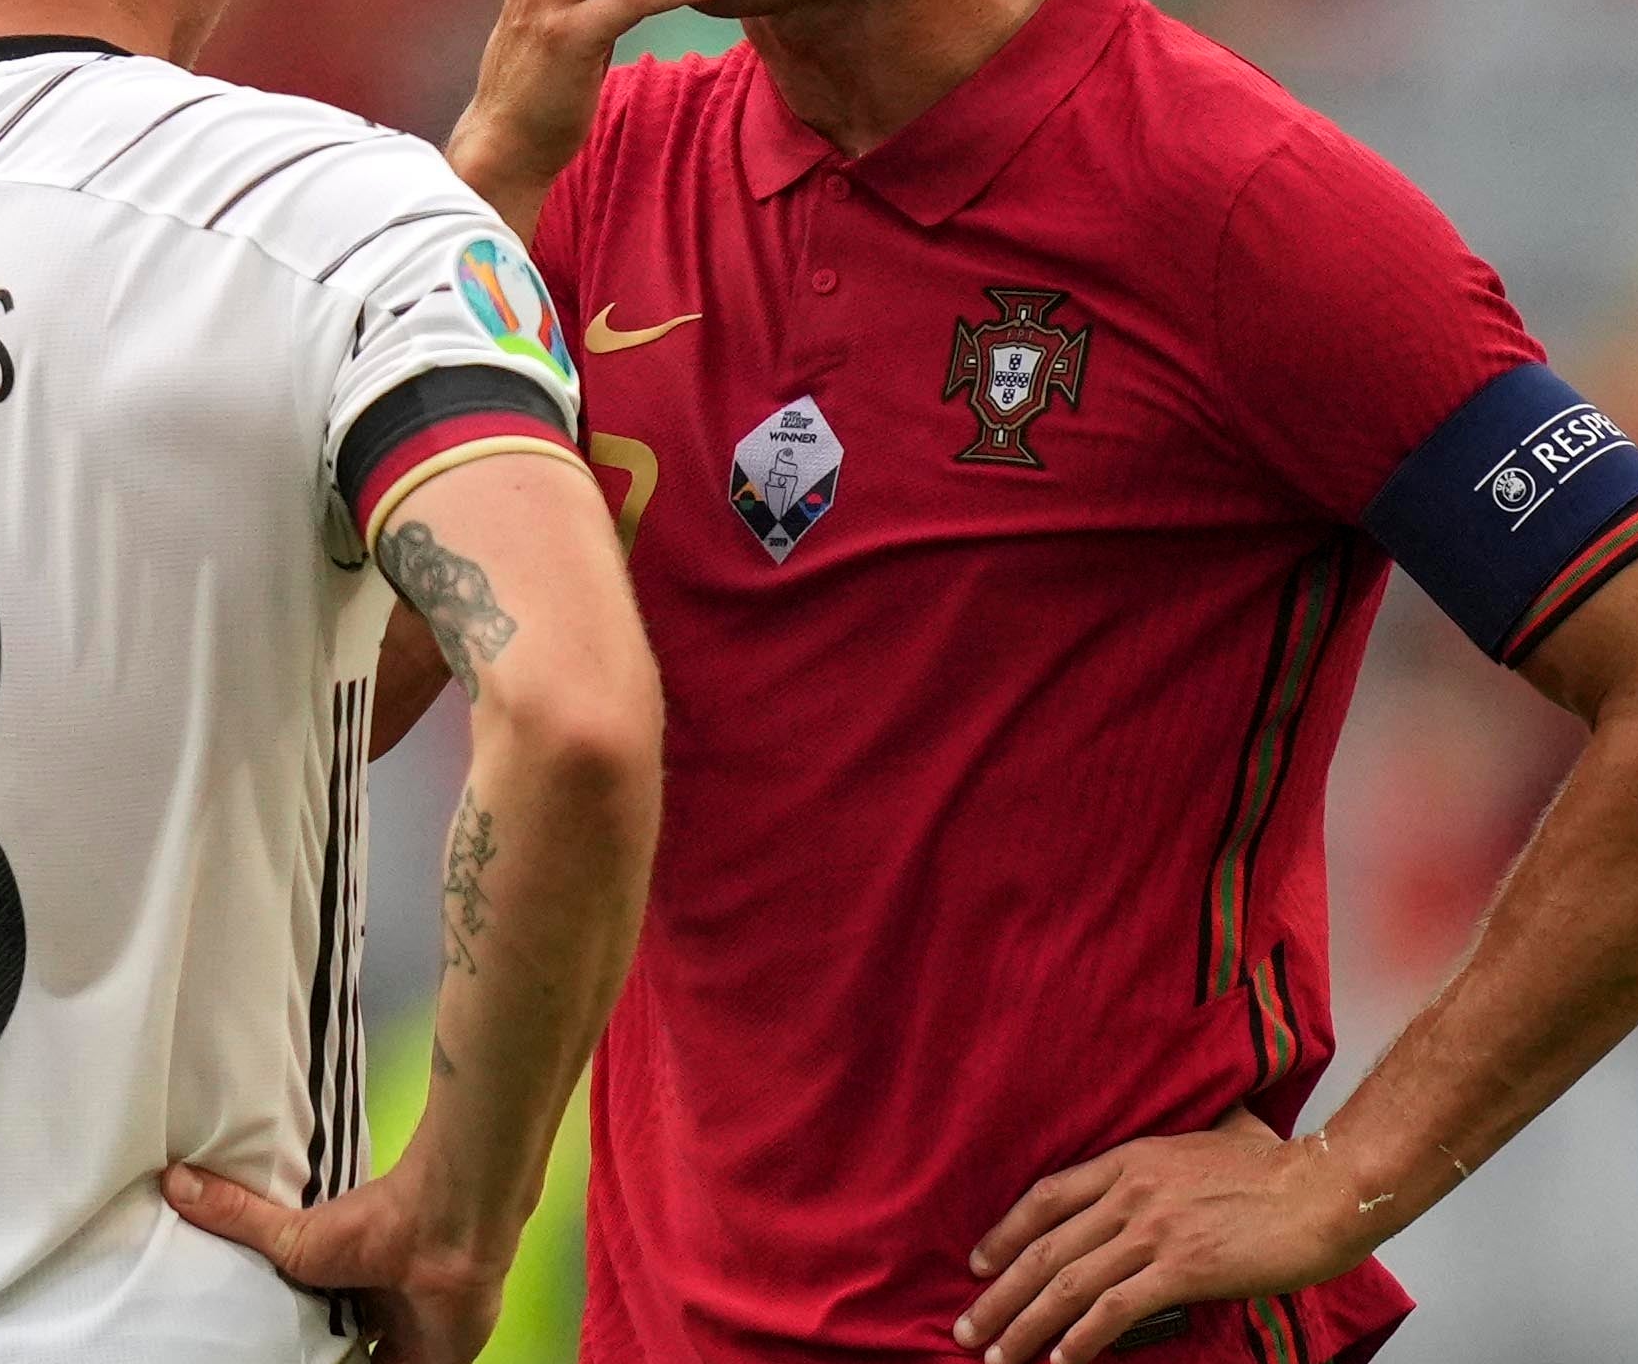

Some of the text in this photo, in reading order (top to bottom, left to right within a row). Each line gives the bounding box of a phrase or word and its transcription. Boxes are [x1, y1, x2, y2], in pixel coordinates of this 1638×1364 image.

[769, 431, 817, 444] WINNER
[1532, 412, 1629, 474] RESPE
[1496, 471, 1516, 492] UEFA
